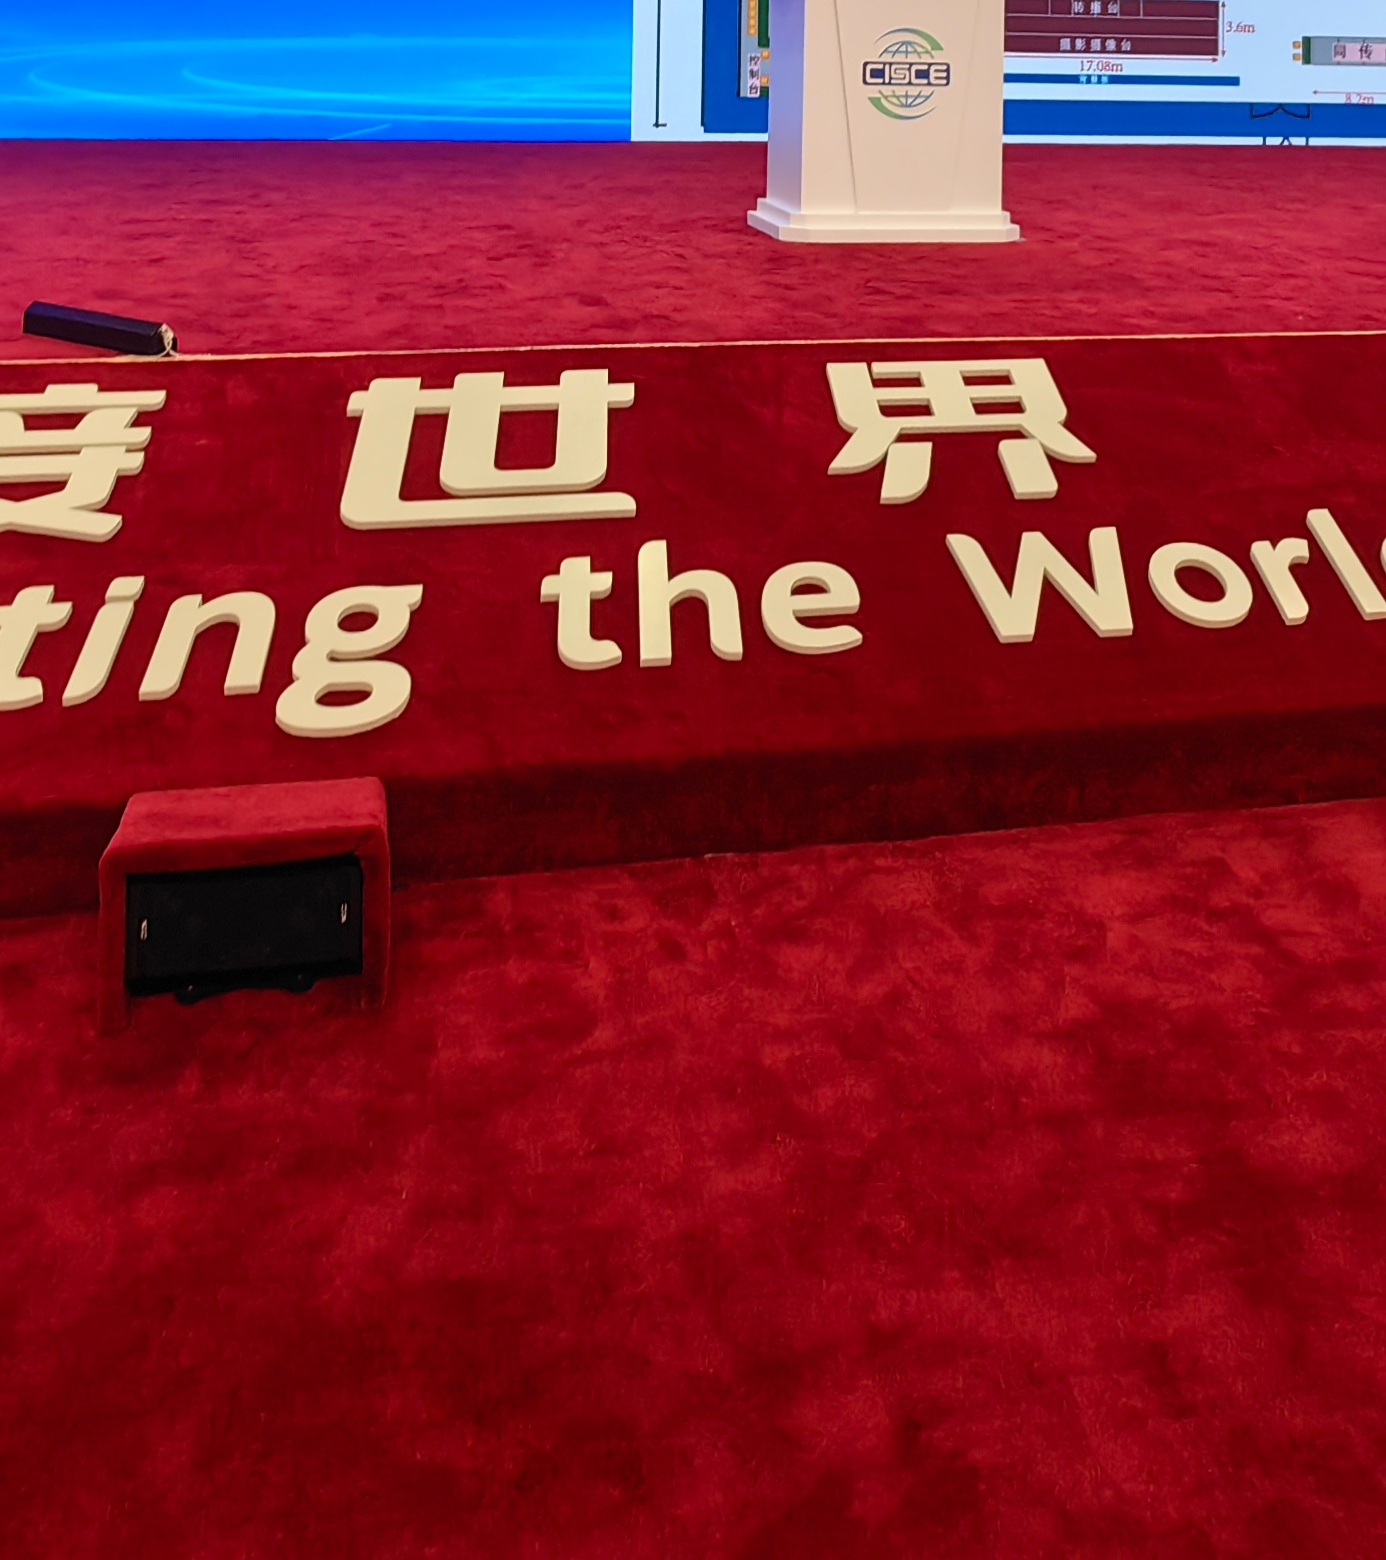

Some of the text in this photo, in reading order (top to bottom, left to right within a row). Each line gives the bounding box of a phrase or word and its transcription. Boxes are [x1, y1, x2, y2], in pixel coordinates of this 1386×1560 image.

[1225, 20, 1256, 34] 3.6m
[866, 63, 949, 85] CISCE
[1080, 59, 1124, 73] 17.08m
[540, 539, 863, 671] the
